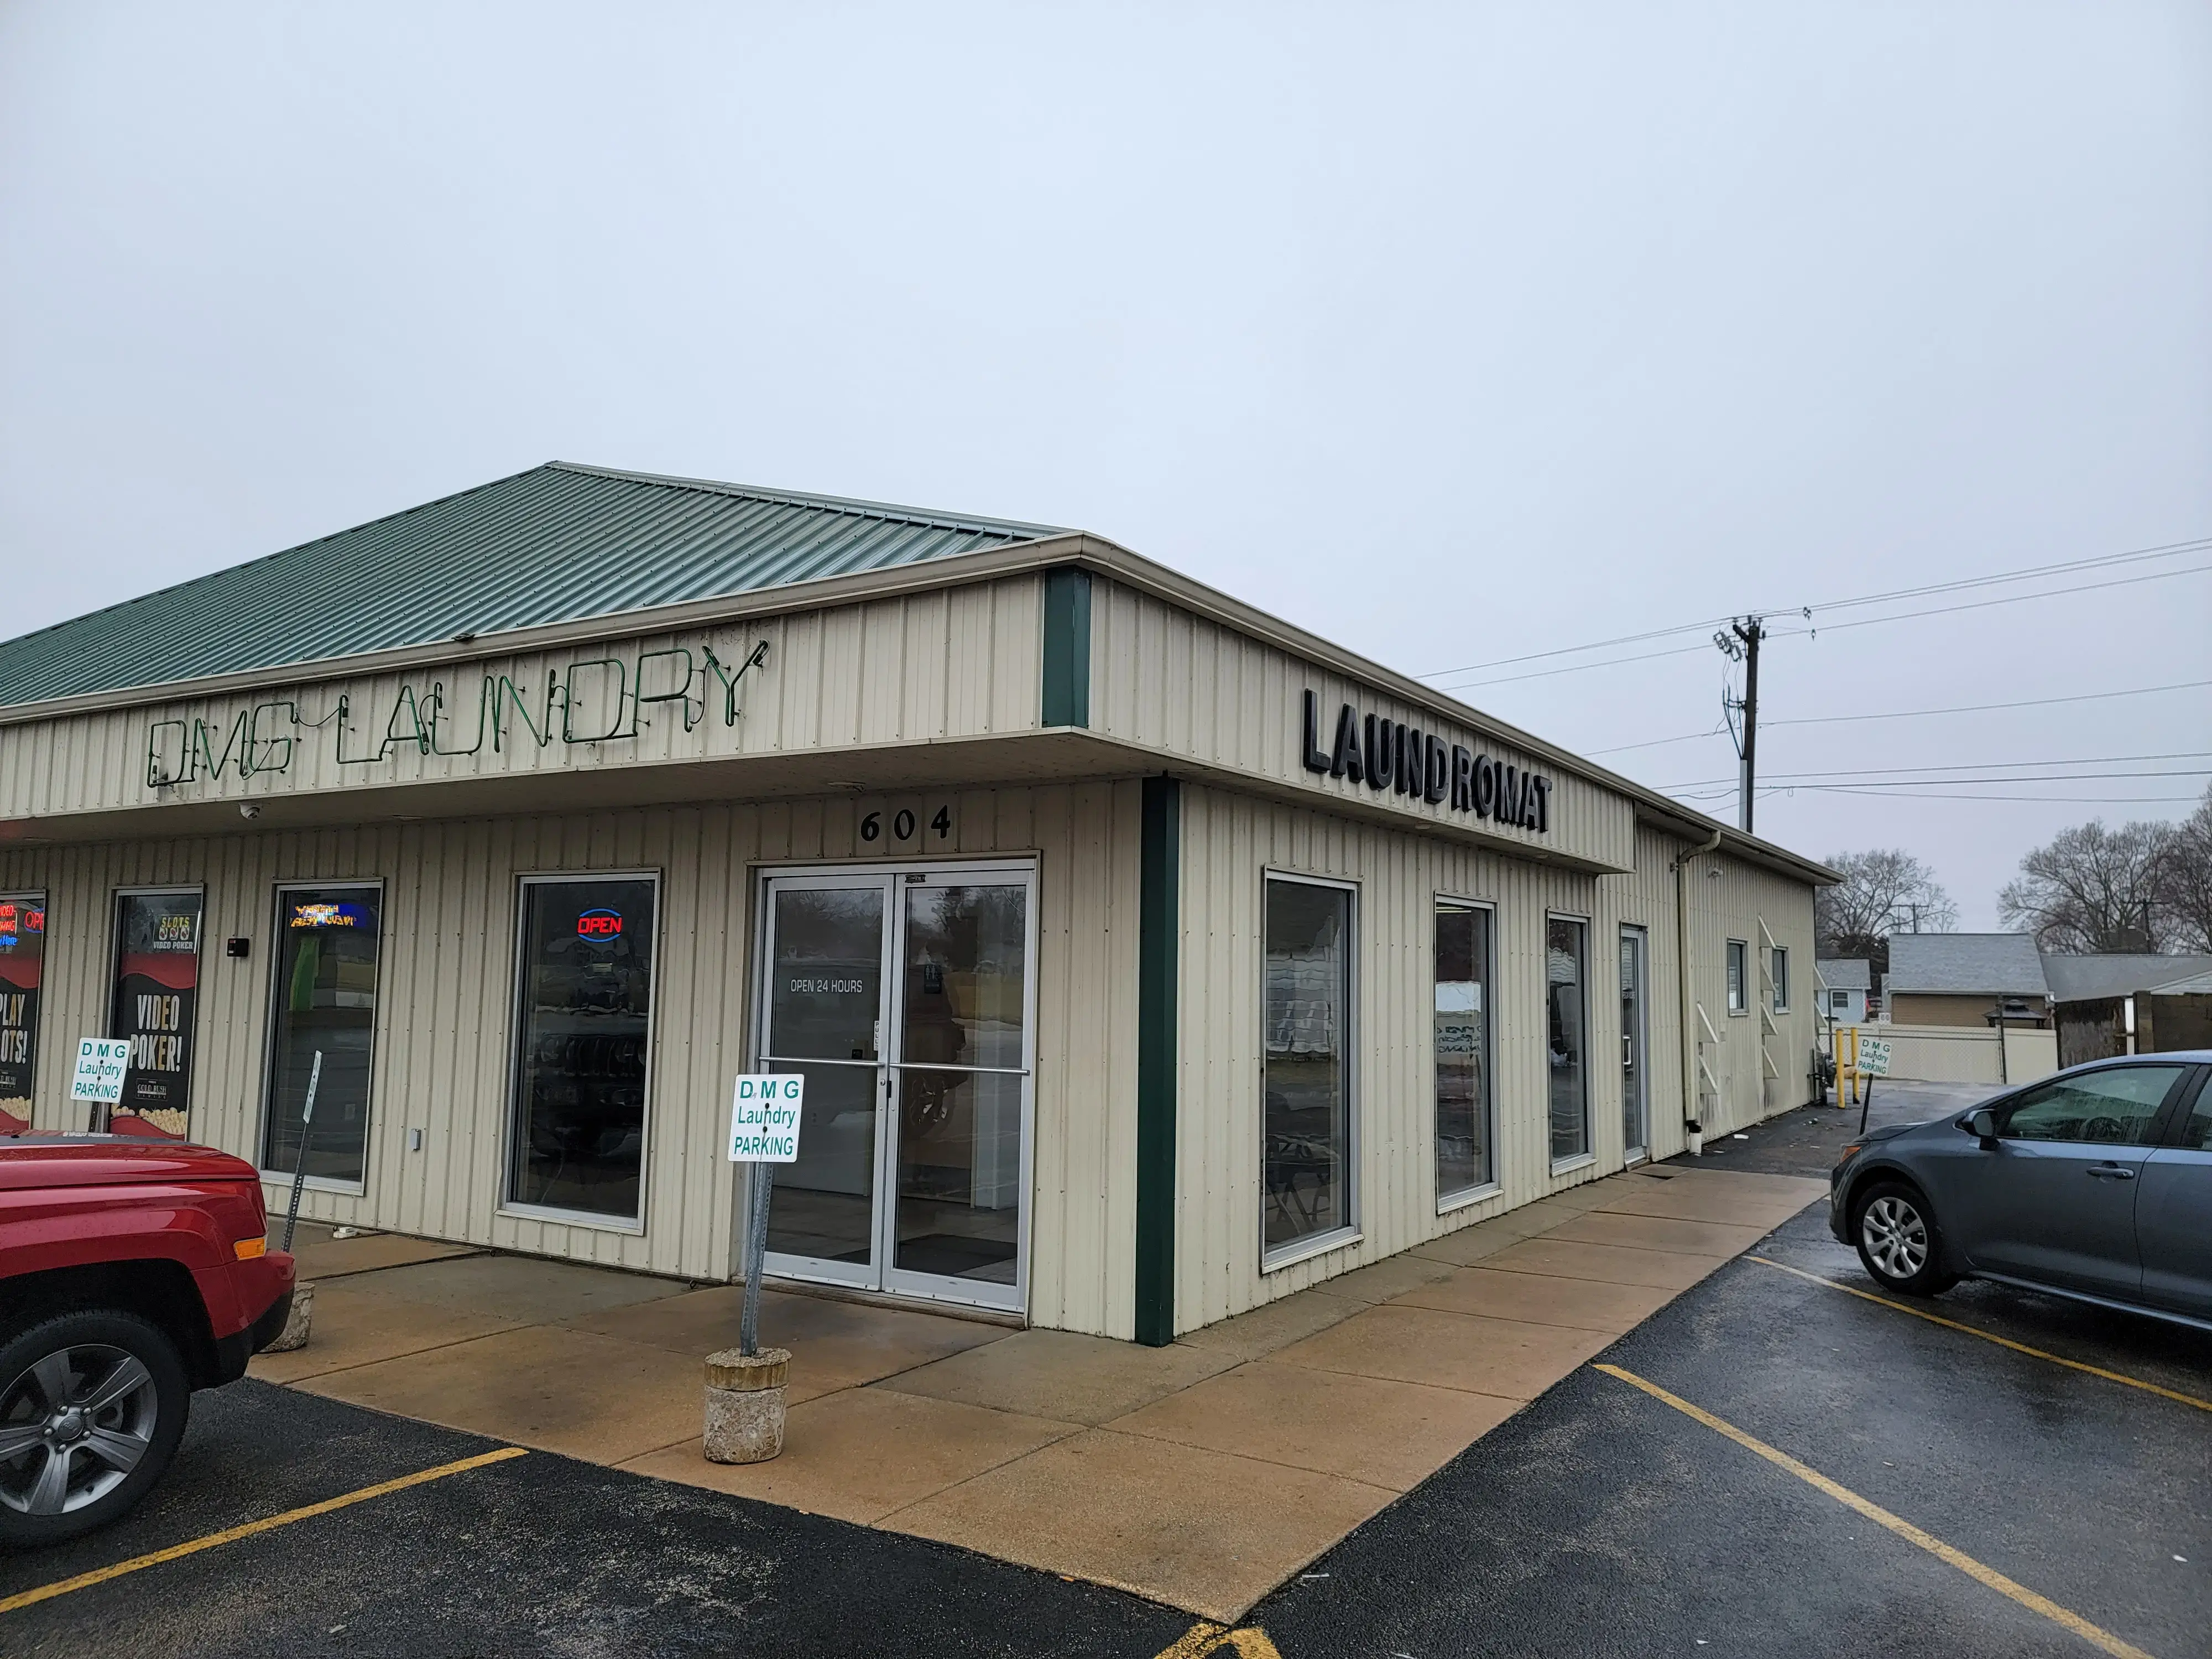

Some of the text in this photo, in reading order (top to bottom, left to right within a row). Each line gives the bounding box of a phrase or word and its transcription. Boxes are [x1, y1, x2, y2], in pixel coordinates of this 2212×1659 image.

[147, 639, 769, 787] DMG LAUNDRY
[1303, 688, 1552, 832] LAUNDROMAT
[860, 805, 951, 842] 604
[0, 905, 14, 917] IDEO
[161, 916, 190, 928] SLOTS
[577, 917, 622, 933] OPEN
[153, 941, 193, 950] VIDEO POKER
[791, 979, 863, 993] OPEN 24 HOURS
[137, 994, 180, 1031] VIDEO
[1, 1029, 28, 1065] OTS!
[128, 1034, 182, 1072] POKER!
[1860, 1048, 1888, 1064] Laundry
[79, 1060, 122, 1080] Laundry
[1858, 1060, 1887, 1074] PARKING
[75, 1082, 118, 1099] PARKING
[738, 1105, 796, 1129] Laundry
[734, 1136, 794, 1156] PARKING
